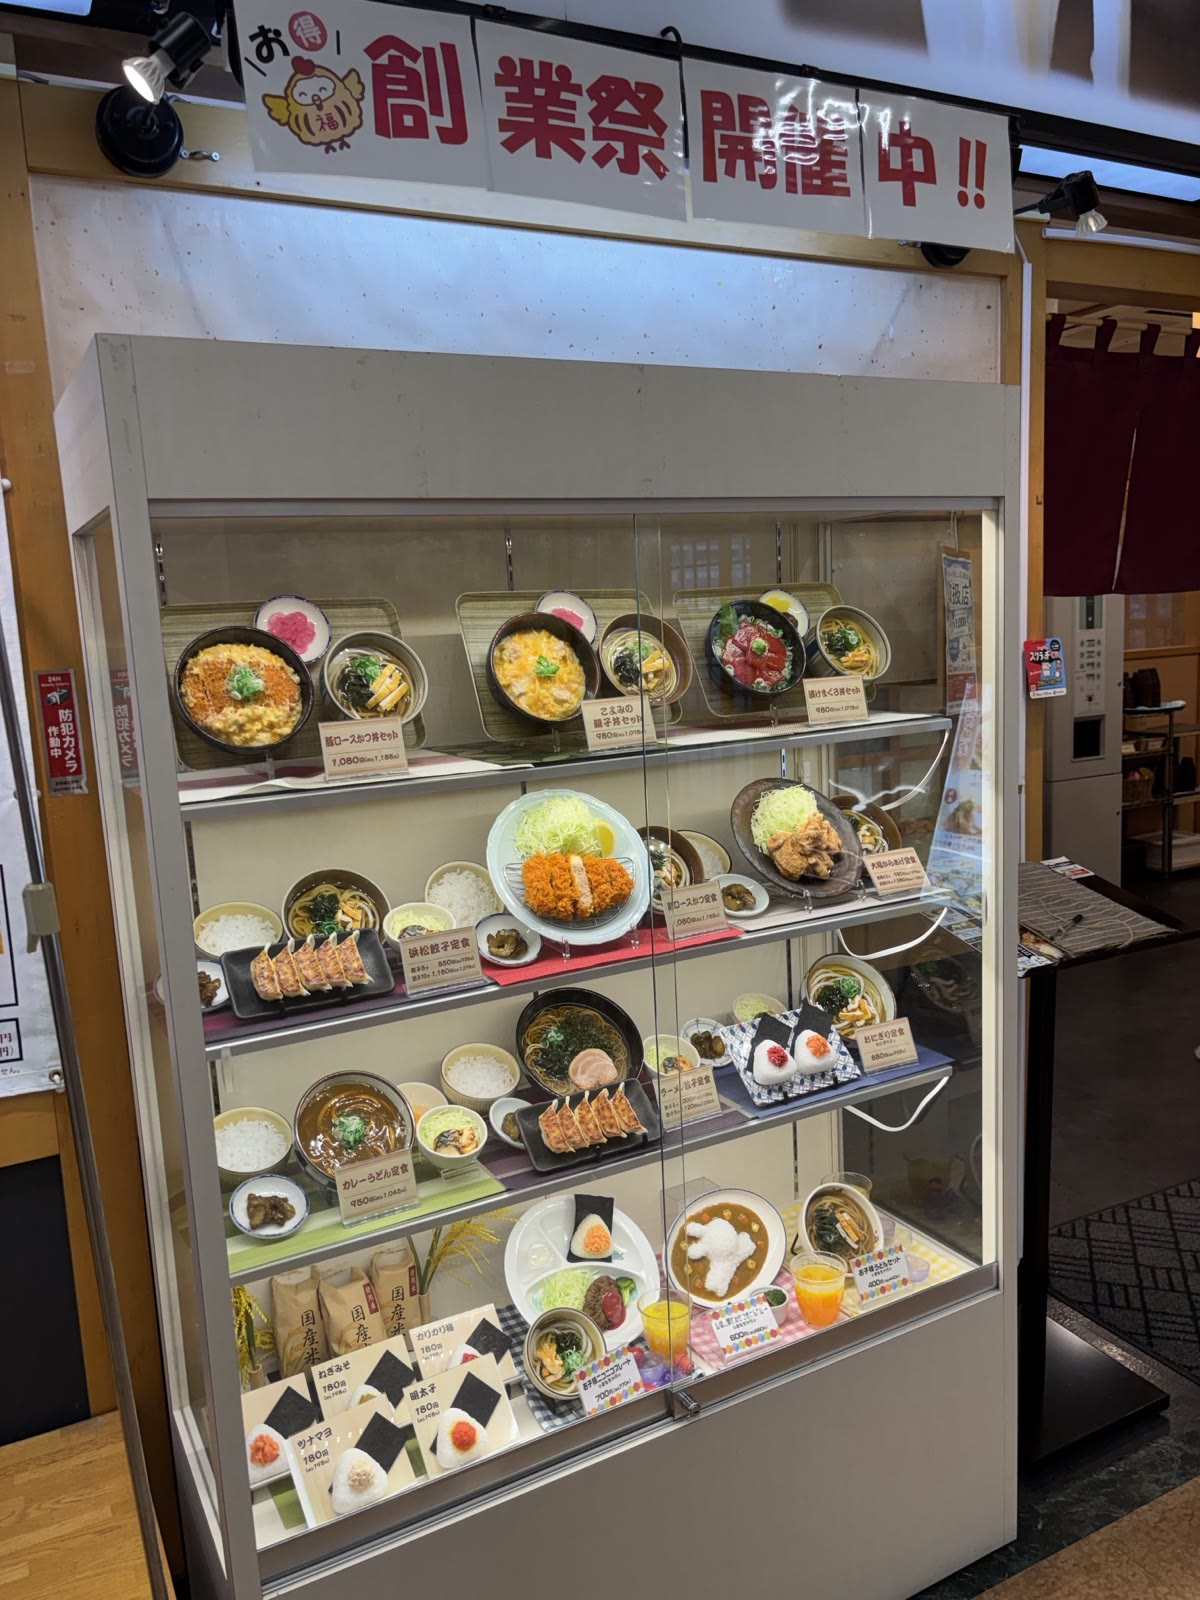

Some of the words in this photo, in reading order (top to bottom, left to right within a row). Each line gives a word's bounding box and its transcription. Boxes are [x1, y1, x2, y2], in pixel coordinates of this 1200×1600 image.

[316, 113, 338, 131] 福
[600, 704, 633, 716] こよみの
[593, 714, 643, 728] 親子丼セット
[47, 725, 62, 758] 作動中
[58, 709, 78, 773] 防犯カメラ
[325, 730, 399, 748] 豚ロースかつ丼セット
[408, 937, 471, 959] 浜松餃子定食
[864, 1027, 905, 1044] おにぎり定食
[342, 1163, 409, 1190] カレーうどん定食
[390, 1285, 406, 1336] 国産米
[351, 1304, 372, 1347] 国産
[301, 1309, 320, 1365] 国産米
[420, 1343, 443, 1354] 180円
[318, 1360, 351, 1380] ねぎみそ
[322, 1380, 346, 1393] 180円
[409, 1383, 436, 1401] 明太子
[415, 1401, 440, 1416] 180円
[297, 1427, 333, 1450] ツナマヨ
[303, 1449, 329, 1465] 180円
